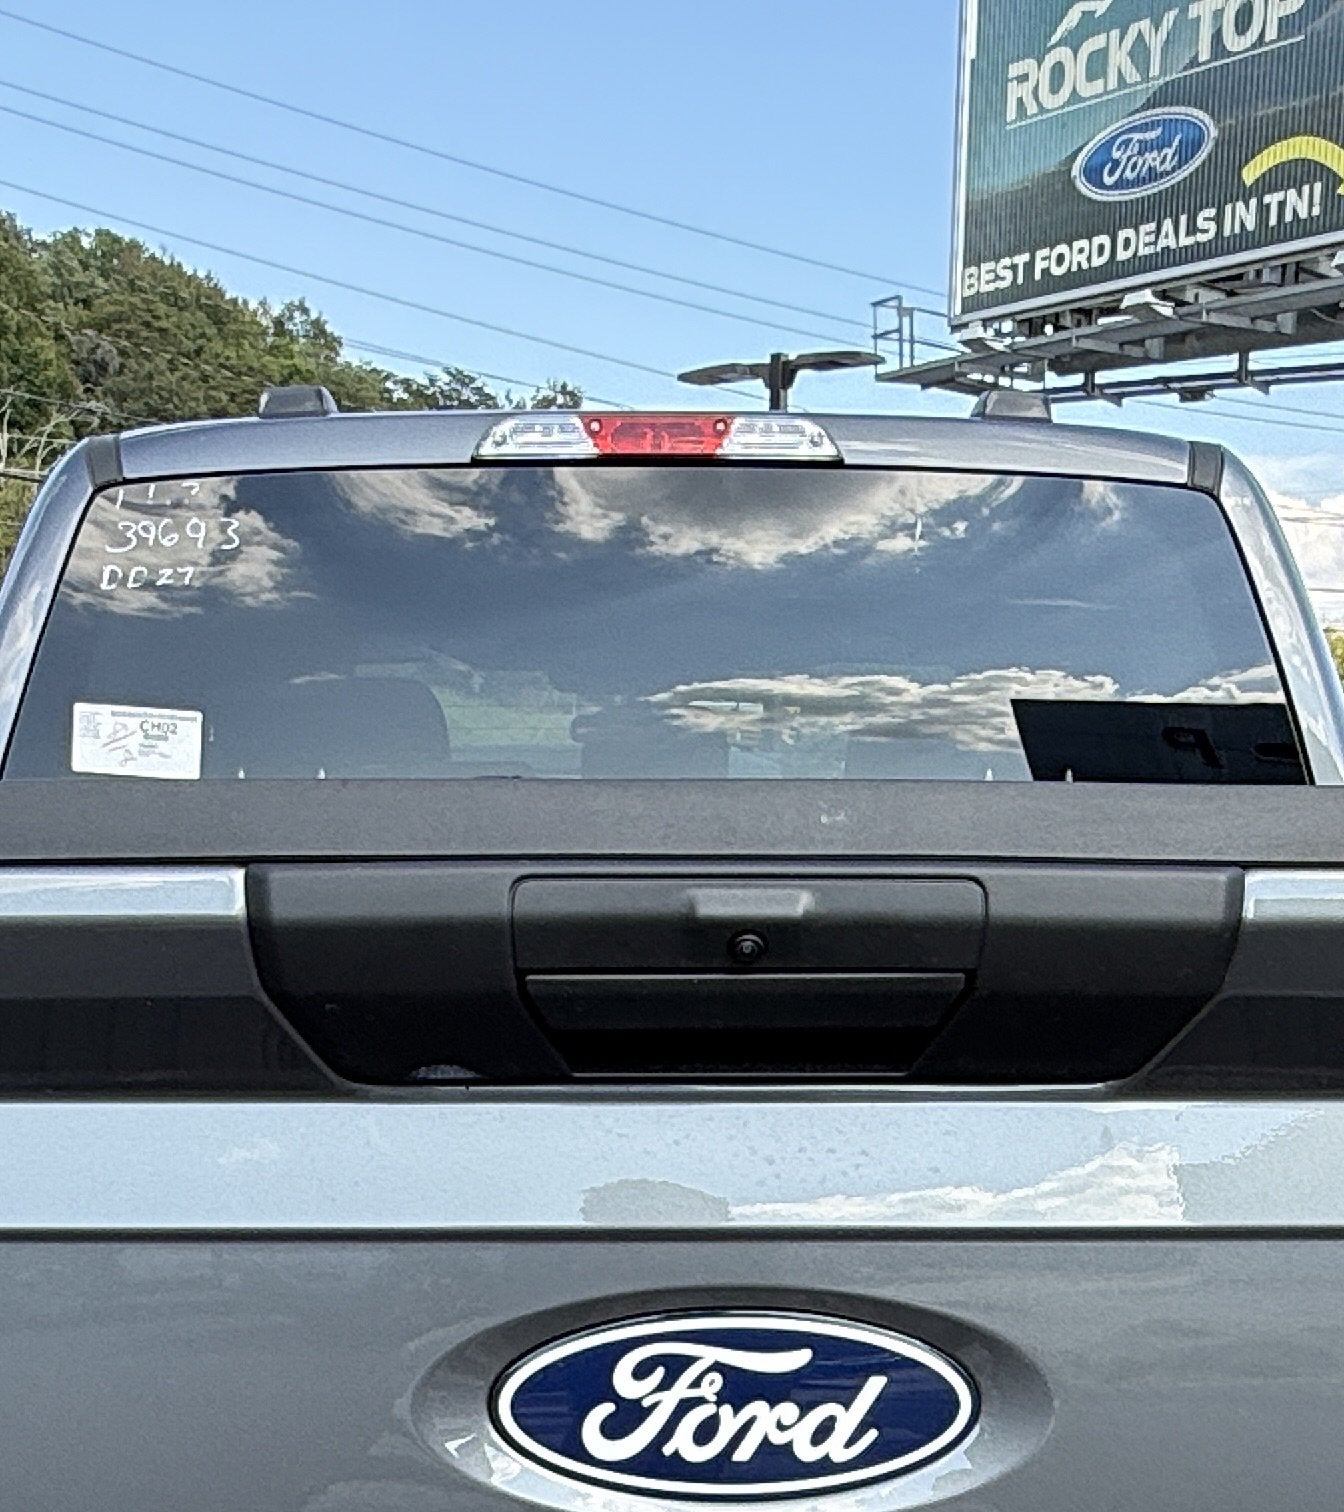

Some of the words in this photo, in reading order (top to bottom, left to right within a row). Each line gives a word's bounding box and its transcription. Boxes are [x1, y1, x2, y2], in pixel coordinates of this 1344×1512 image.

[1006, 8, 1179, 123] ROCKY
[1188, 0, 1309, 63] TOP
[1102, 126, 1182, 187] Ford
[961, 252, 1030, 298] BEST
[1034, 234, 1112, 281] FORD
[1116, 207, 1217, 261] DEALS
[1222, 197, 1258, 238] IN
[1263, 182, 1323, 229] TN!
[580, 1341, 888, 1464] Ford
